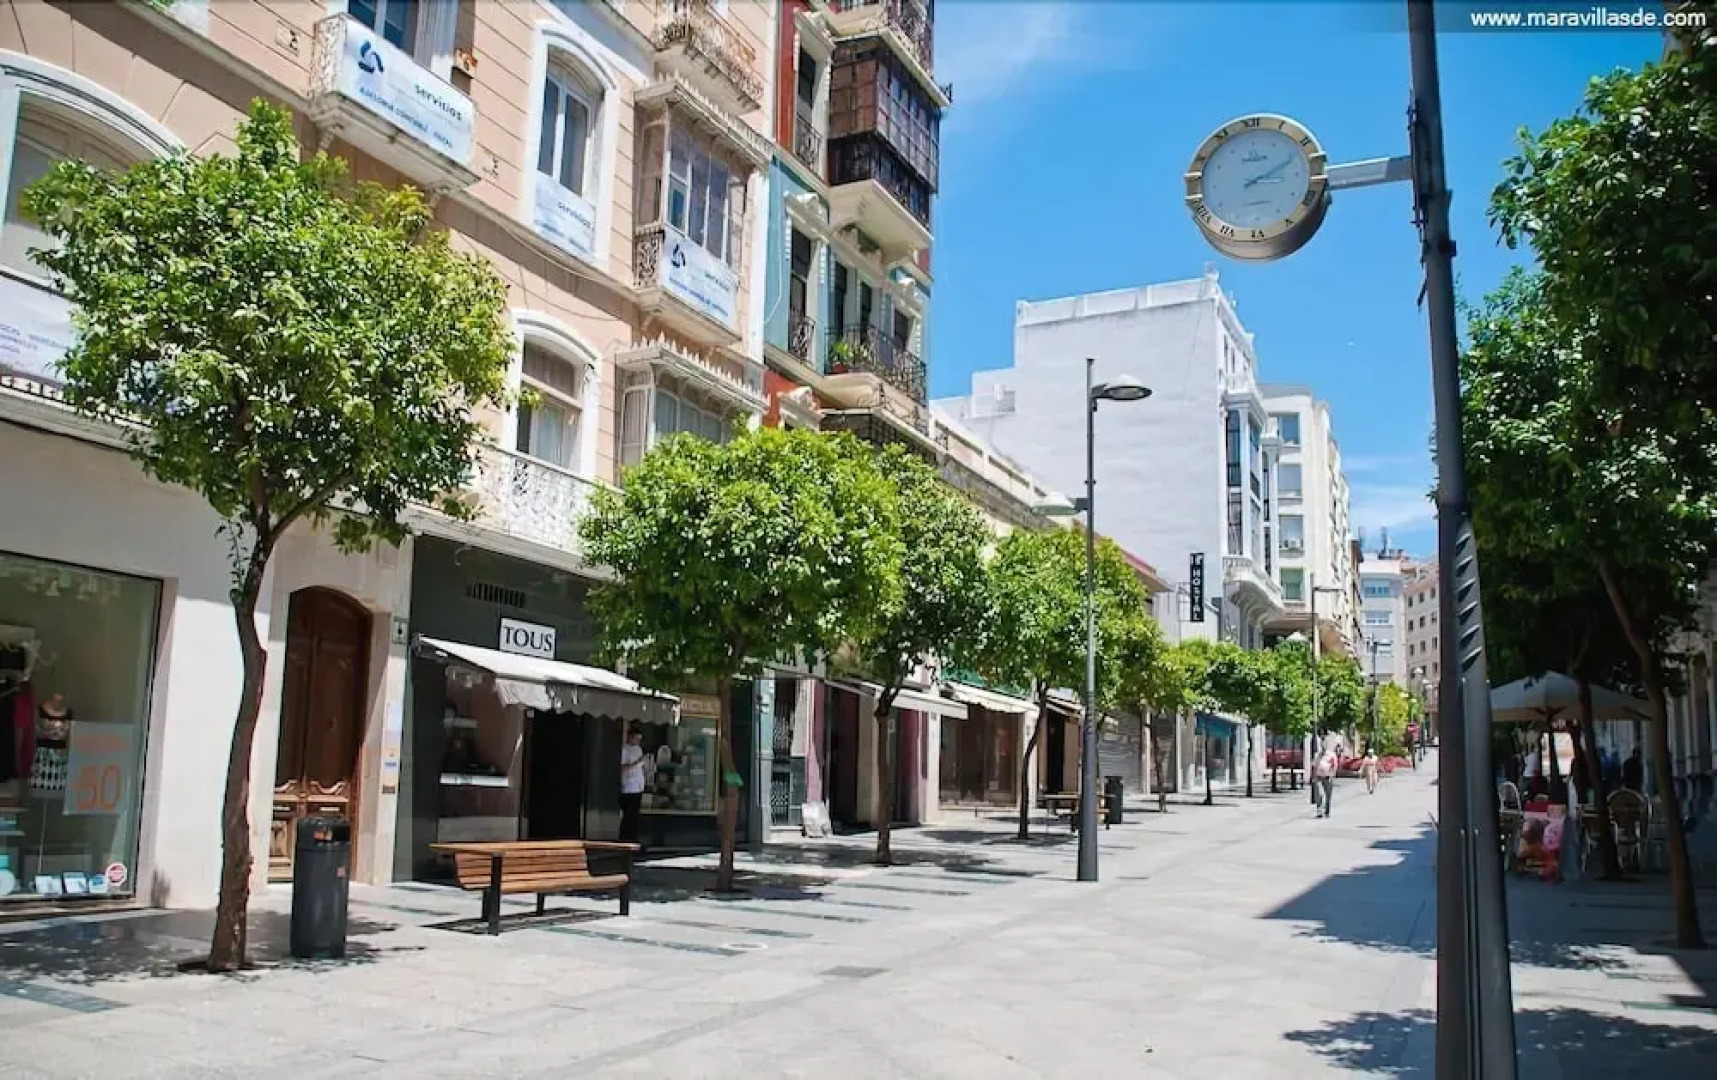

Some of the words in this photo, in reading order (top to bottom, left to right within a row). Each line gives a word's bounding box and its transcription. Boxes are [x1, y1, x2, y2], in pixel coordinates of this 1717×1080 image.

[415, 84, 462, 121] servicios
[1192, 568, 1201, 620] HOSTAL
[503, 625, 552, 651] TOUS
